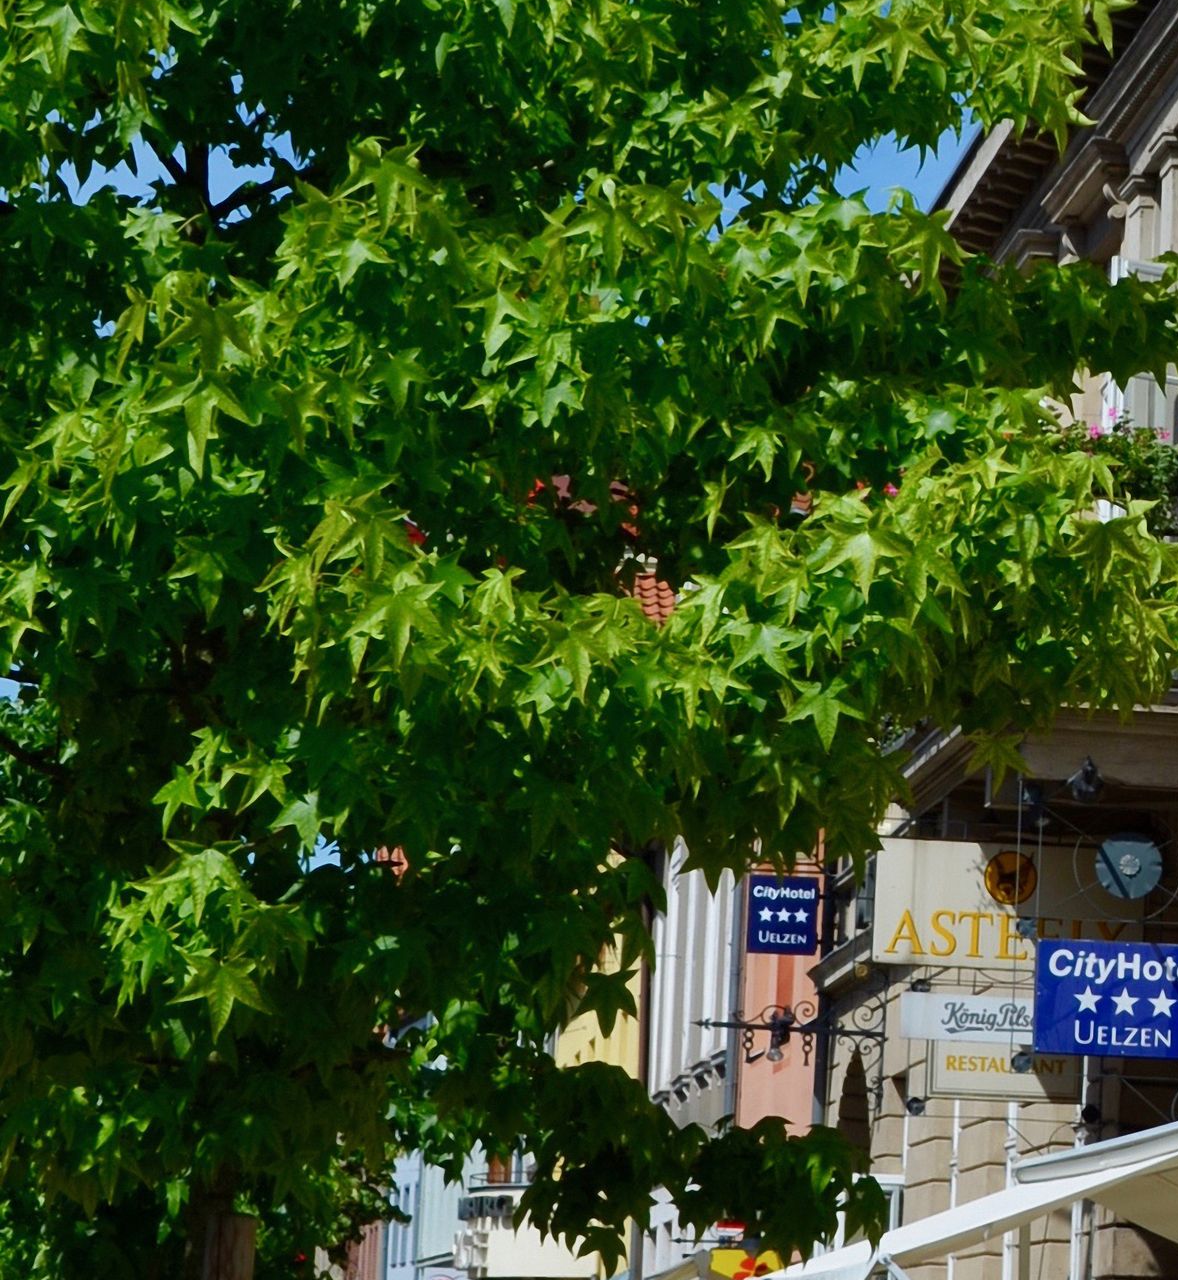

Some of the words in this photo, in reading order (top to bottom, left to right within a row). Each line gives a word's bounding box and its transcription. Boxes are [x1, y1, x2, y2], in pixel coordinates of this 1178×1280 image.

[753, 885, 815, 901] CityHotel
[941, 1002, 996, 1031] König
[946, 1055, 1066, 1074] RESTAUANT
